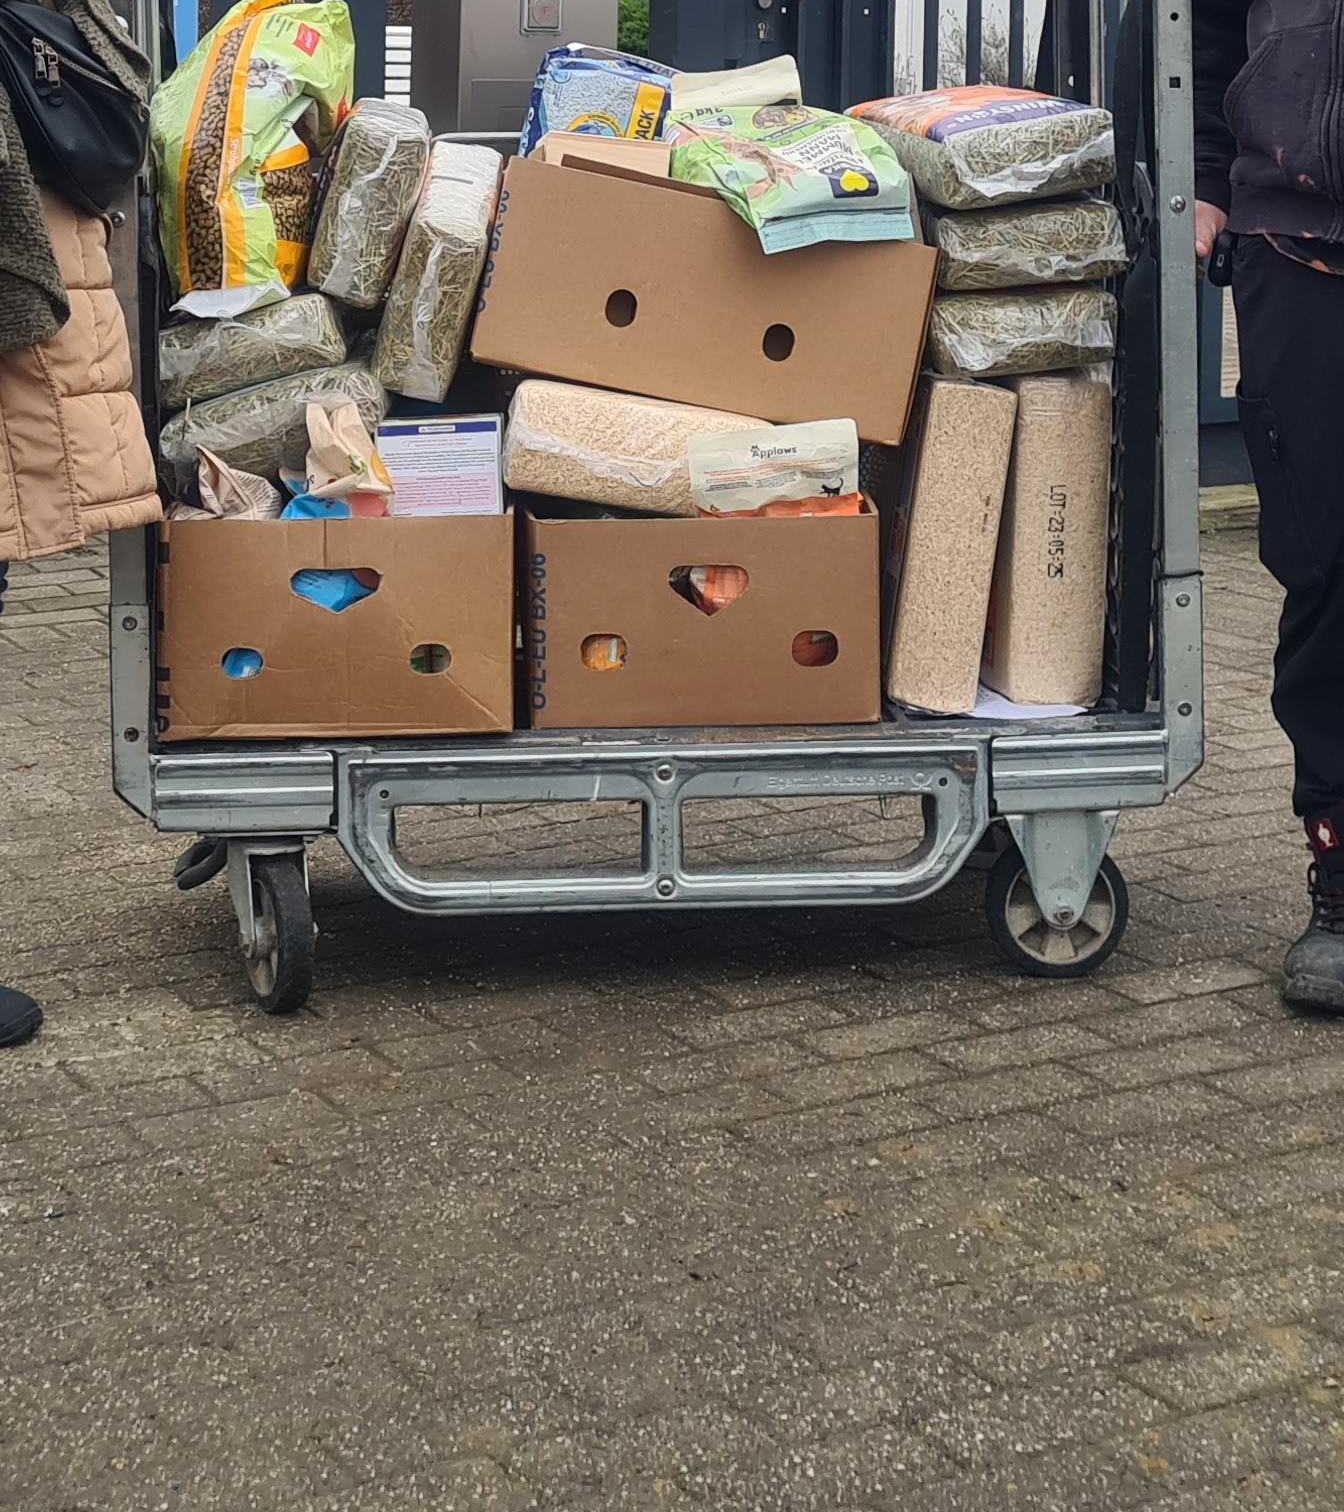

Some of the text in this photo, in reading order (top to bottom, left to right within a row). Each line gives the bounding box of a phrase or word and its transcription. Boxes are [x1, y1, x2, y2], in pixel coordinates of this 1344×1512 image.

[635, 110, 655, 140] ACK
[956, 99, 1067, 125] WINSTON
[750, 444, 798, 459] Applaws
